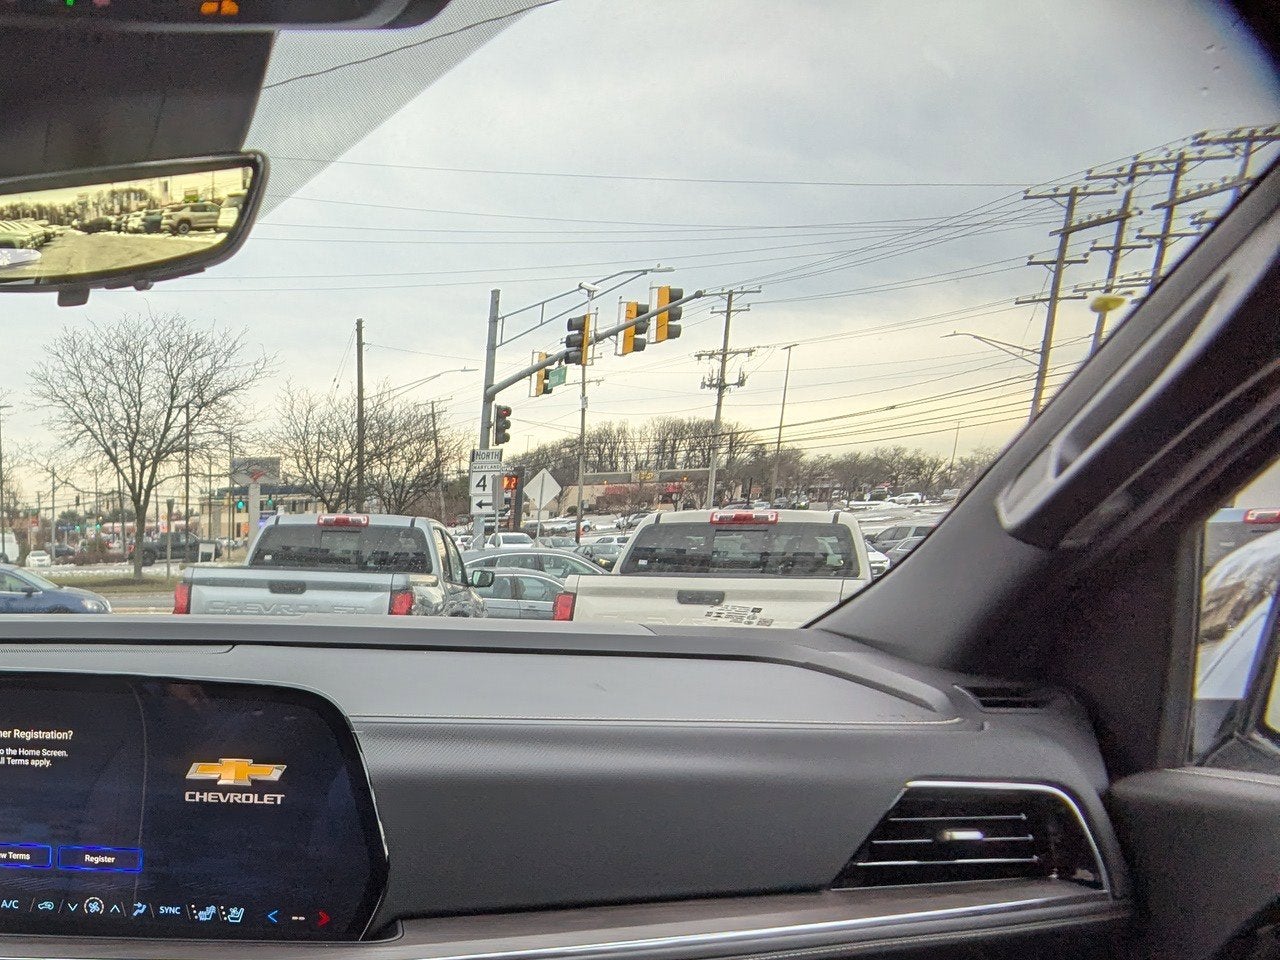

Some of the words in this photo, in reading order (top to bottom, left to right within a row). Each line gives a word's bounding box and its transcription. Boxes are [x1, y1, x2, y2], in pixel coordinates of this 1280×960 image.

[476, 451, 499, 460] NORTH
[475, 474, 487, 492] 4
[13, 729, 74, 741] Registration?
[5, 747, 18, 755] the
[18, 748, 40, 756] Home
[41, 748, 68, 757] Screen.
[6, 757, 29, 766] Terms
[30, 758, 52, 768] apply.
[185, 791, 285, 805] CHEVROLET
[7, 851, 31, 860] Terms
[84, 854, 116, 864] Register
[0, 899, 19, 909] A/C
[159, 906, 181, 915] SYNC
